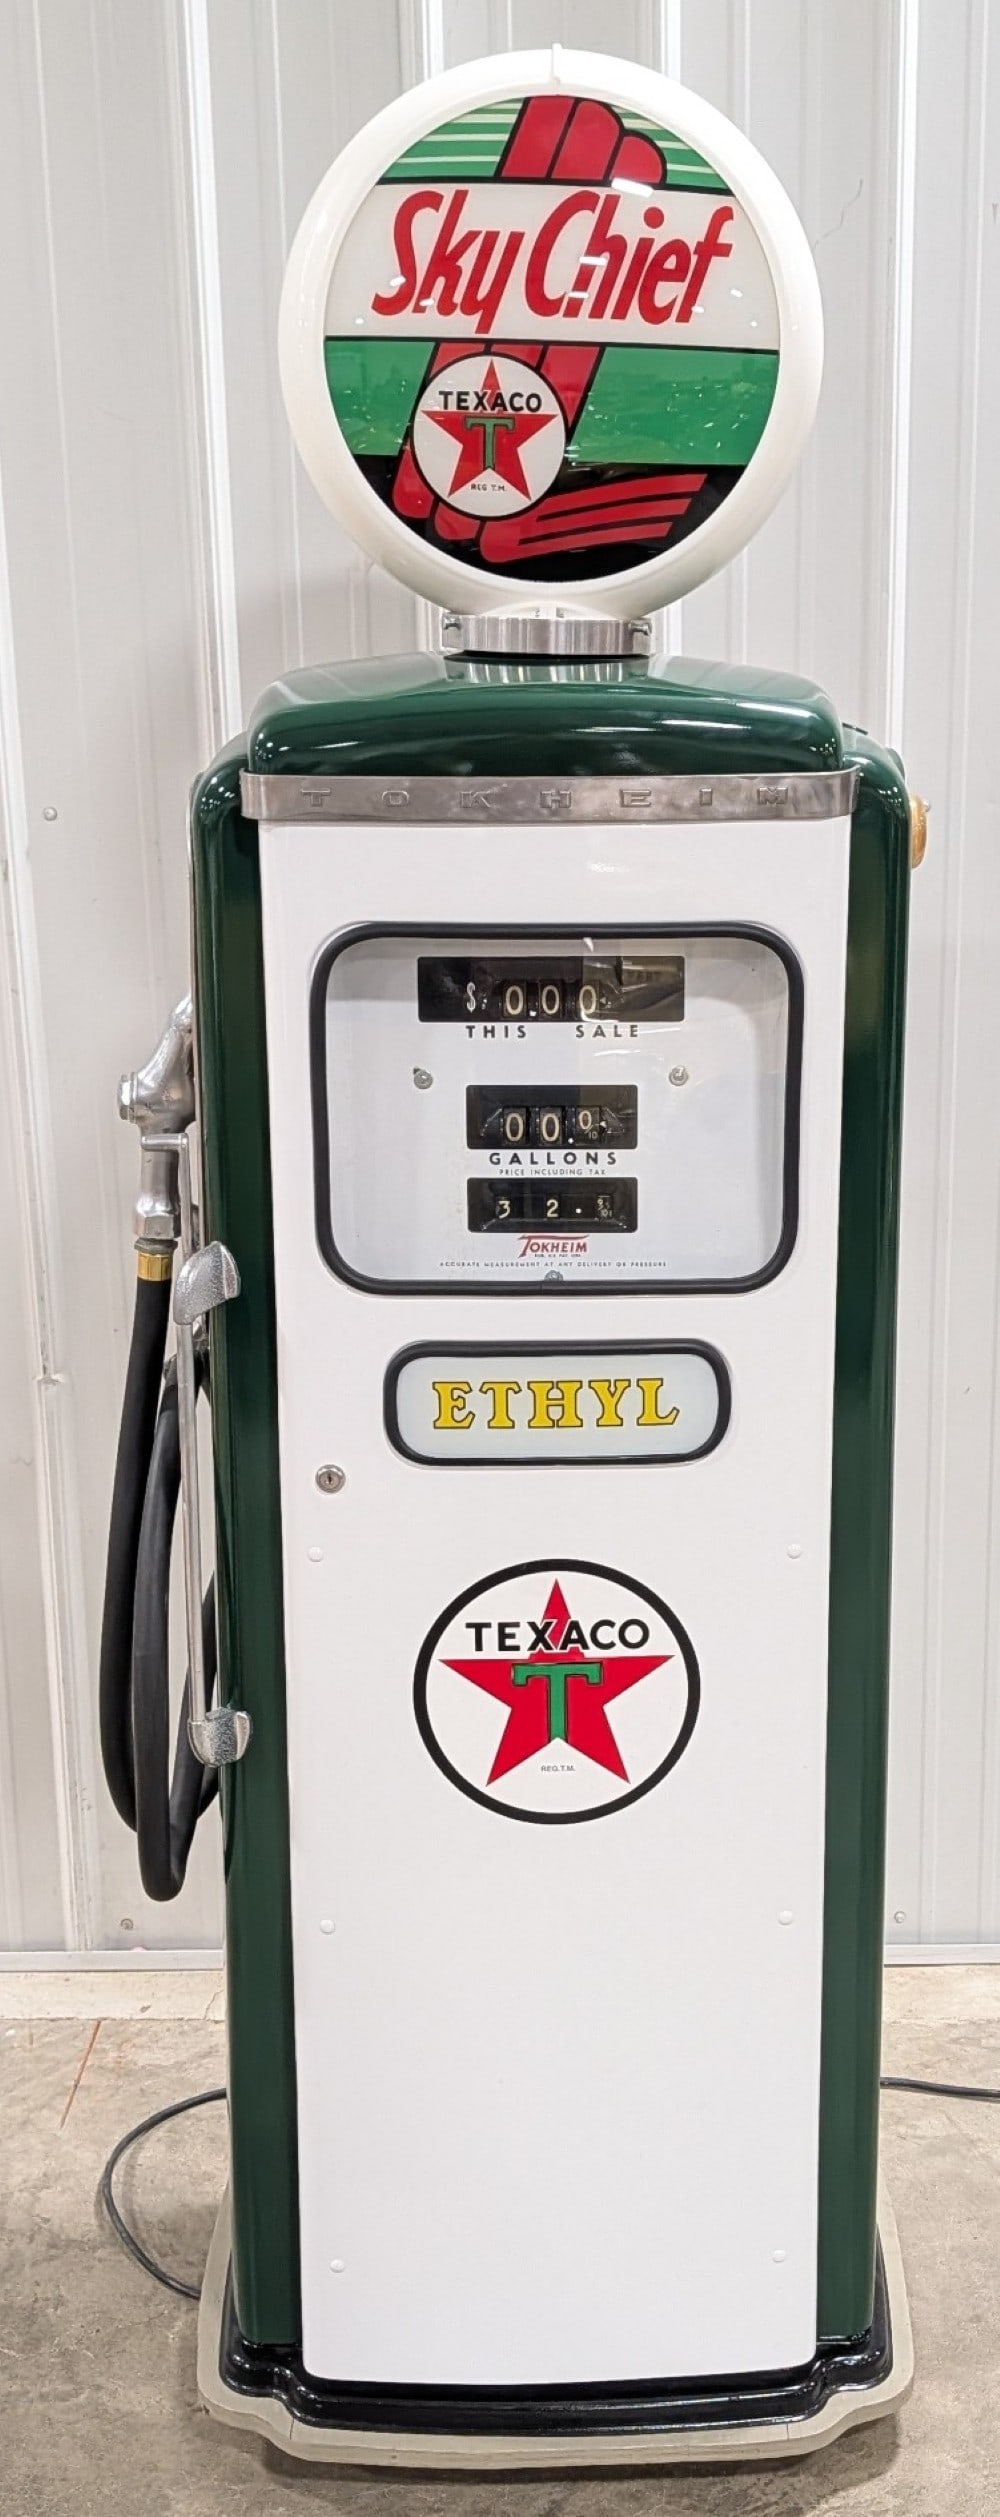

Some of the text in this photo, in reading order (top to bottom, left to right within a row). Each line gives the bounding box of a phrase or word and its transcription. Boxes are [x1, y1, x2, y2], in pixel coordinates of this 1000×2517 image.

[371, 188, 735, 335] Sky Chief
[438, 390, 542, 413] TEXACO
[464, 415, 516, 472] T
[300, 786, 790, 811] TOKHEIM
[466, 981, 477, 1013] $
[465, 1024, 640, 1039] THIS SALE
[489, 1151, 617, 1166] GALLONS
[499, 1168, 607, 1176] PRICE INCLUDING TAX
[517, 1234, 590, 1259] TOKHEIM
[431, 1376, 680, 1431] ETHYL
[465, 1617, 651, 1653] TEXACO
[510, 1661, 604, 1742] T
